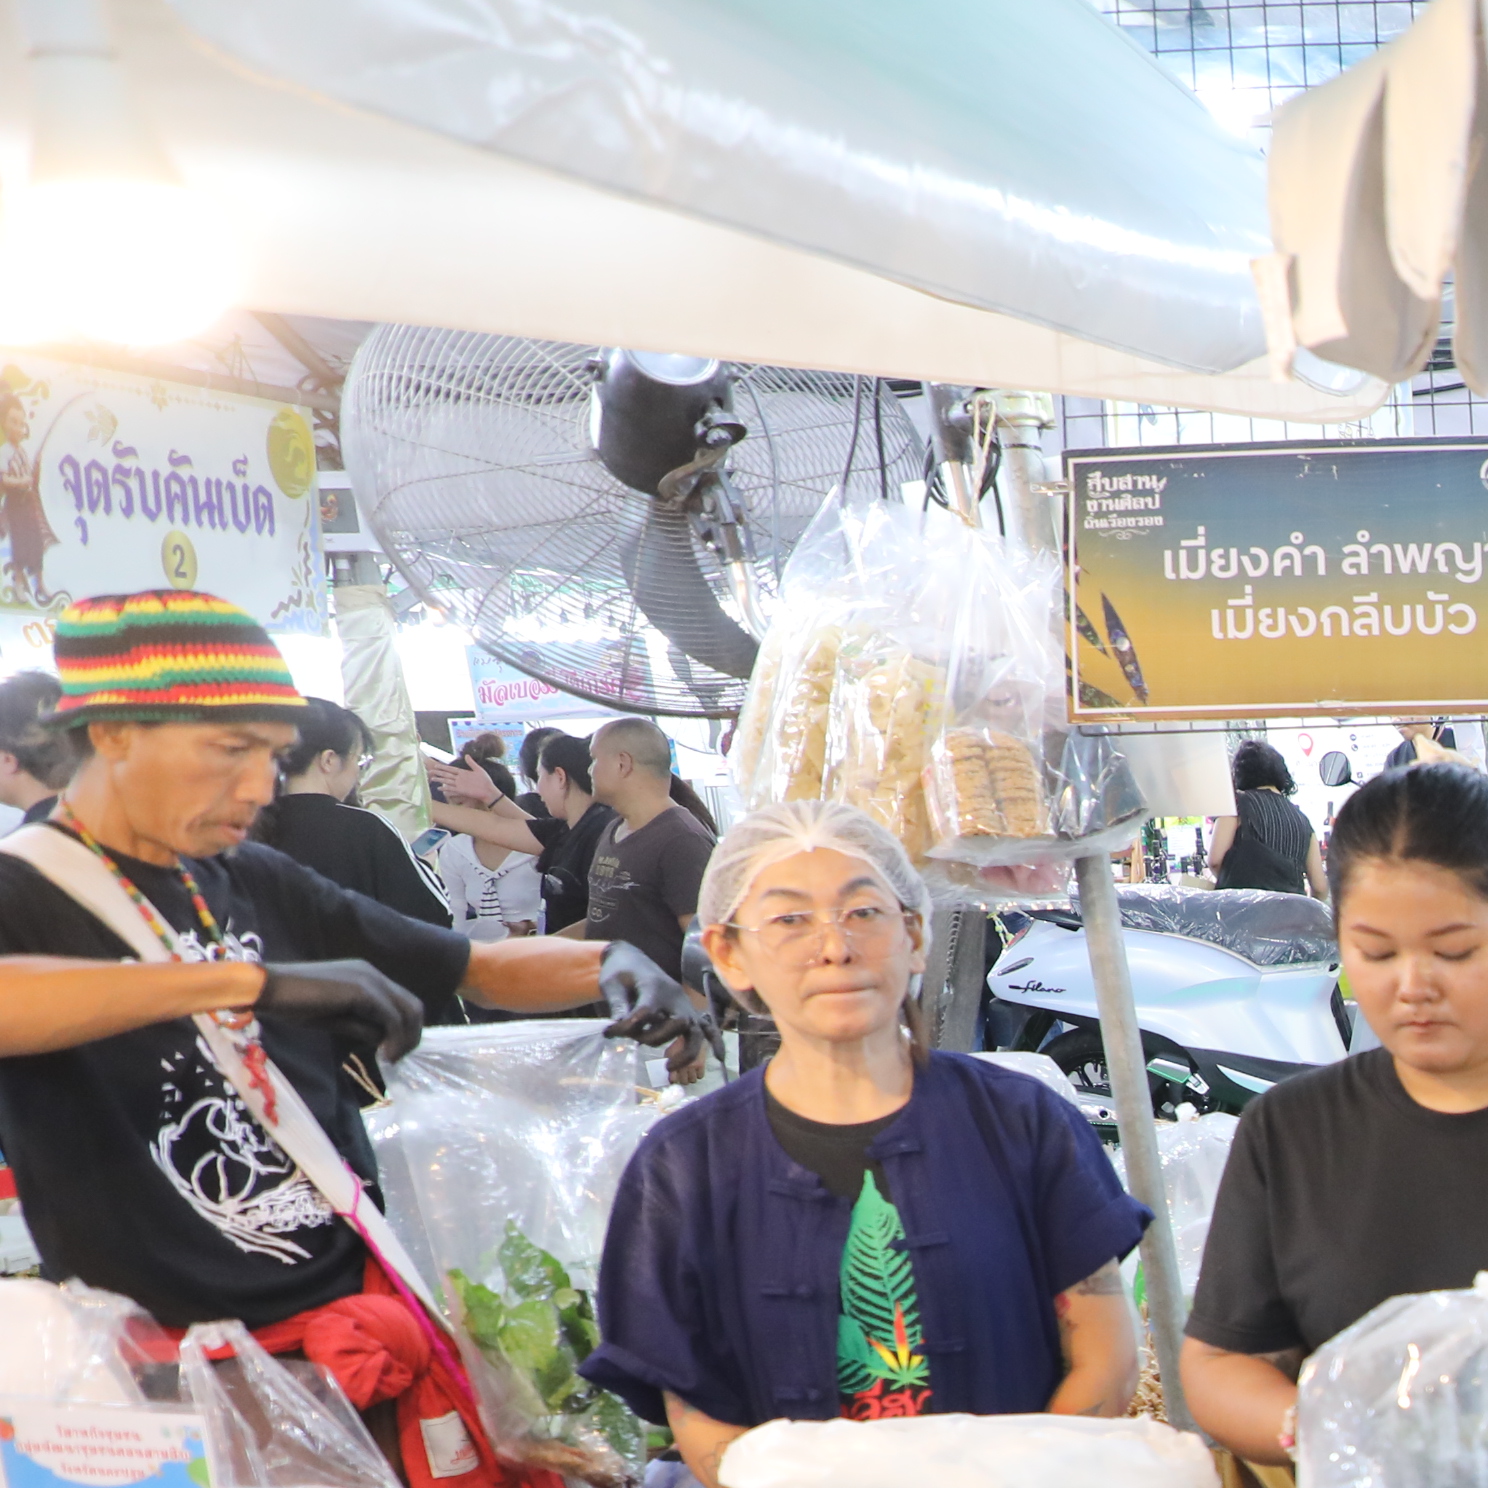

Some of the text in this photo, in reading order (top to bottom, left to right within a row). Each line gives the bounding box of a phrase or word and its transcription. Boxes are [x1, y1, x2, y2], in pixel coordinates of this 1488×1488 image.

[58, 440, 276, 545] จุดรับคันเบ็ด
[171, 543, 188, 579] 2
[1163, 526, 1326, 580] เมี่ยงคำ
[1210, 585, 1478, 640] เมี่ยงกลีบบัว
